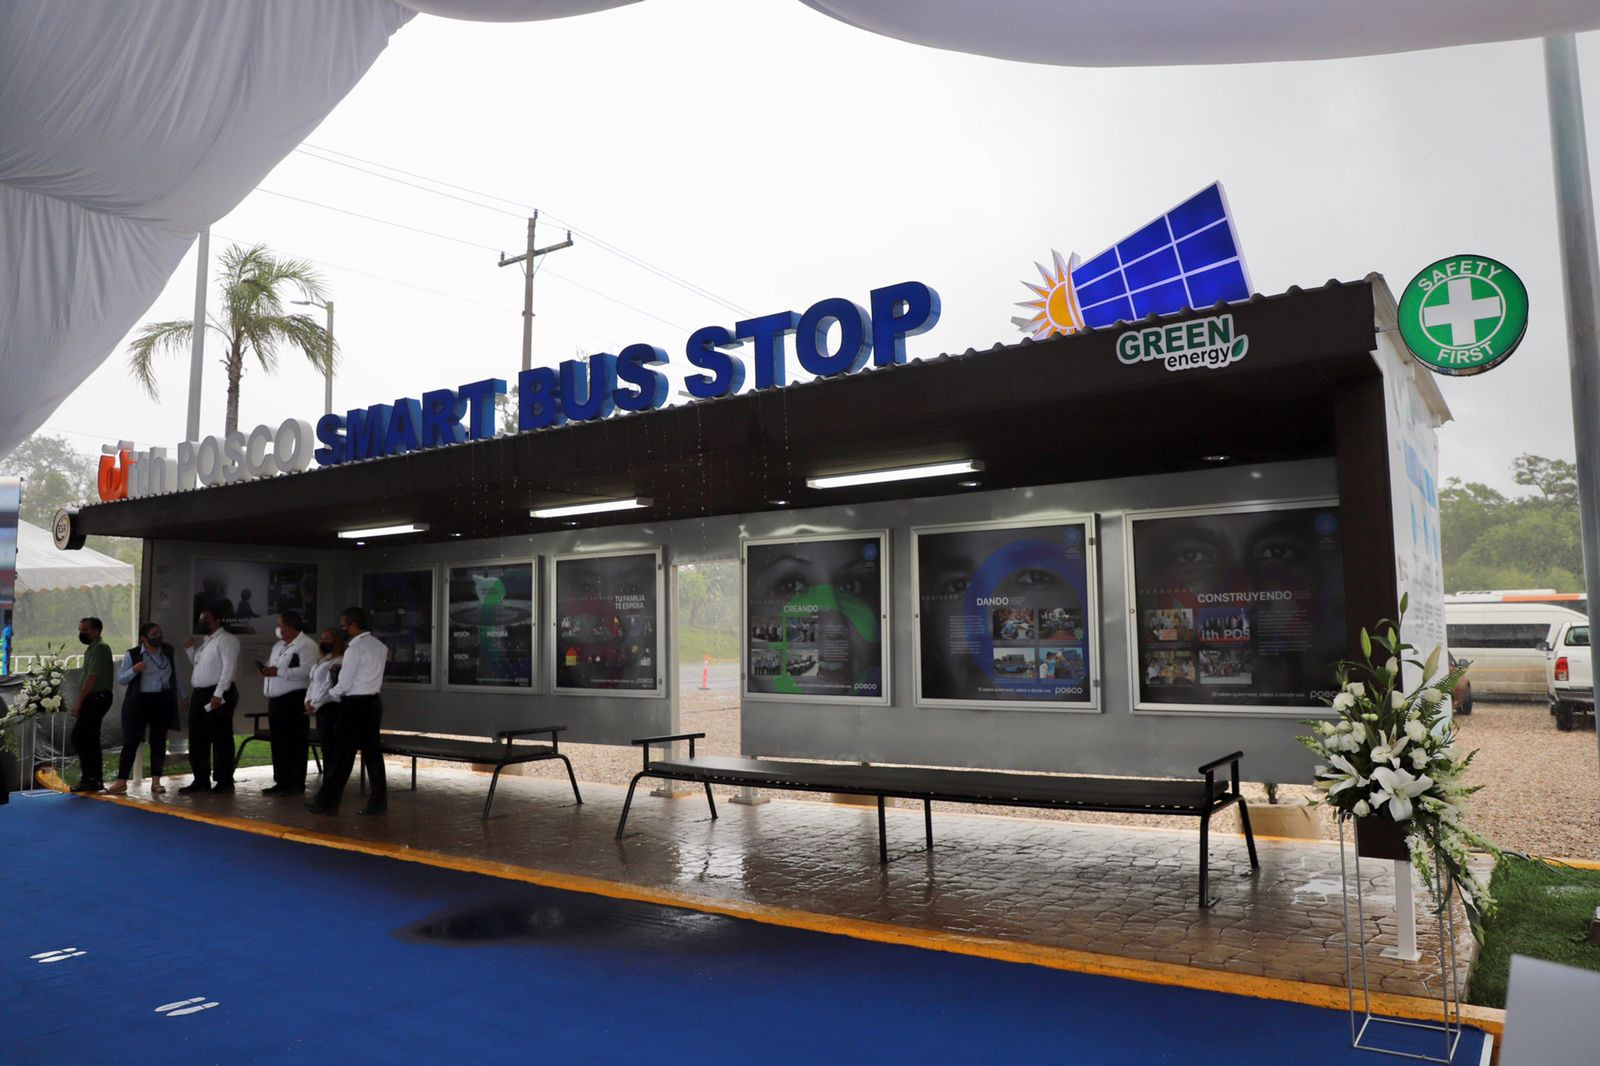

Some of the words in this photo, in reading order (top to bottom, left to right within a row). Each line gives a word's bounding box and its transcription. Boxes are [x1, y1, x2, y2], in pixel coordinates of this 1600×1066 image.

[1418, 260, 1503, 291] SAFETY
[1118, 317, 1231, 360] GREEN
[1166, 346, 1230, 368] energy
[1437, 341, 1493, 364] FIRST
[178, 418, 314, 492] POSCO
[314, 378, 508, 466] SMART
[518, 343, 670, 431] BUS
[684, 281, 942, 398] STOP
[622, 594, 645, 602] FAMILIA
[976, 596, 1009, 607] DANDO
[1197, 590, 1293, 604] CONSTRUYENDO
[622, 602, 644, 610] ESPERA
[783, 604, 819, 613] CREANDO
[1310, 690, 1338, 699] posc
